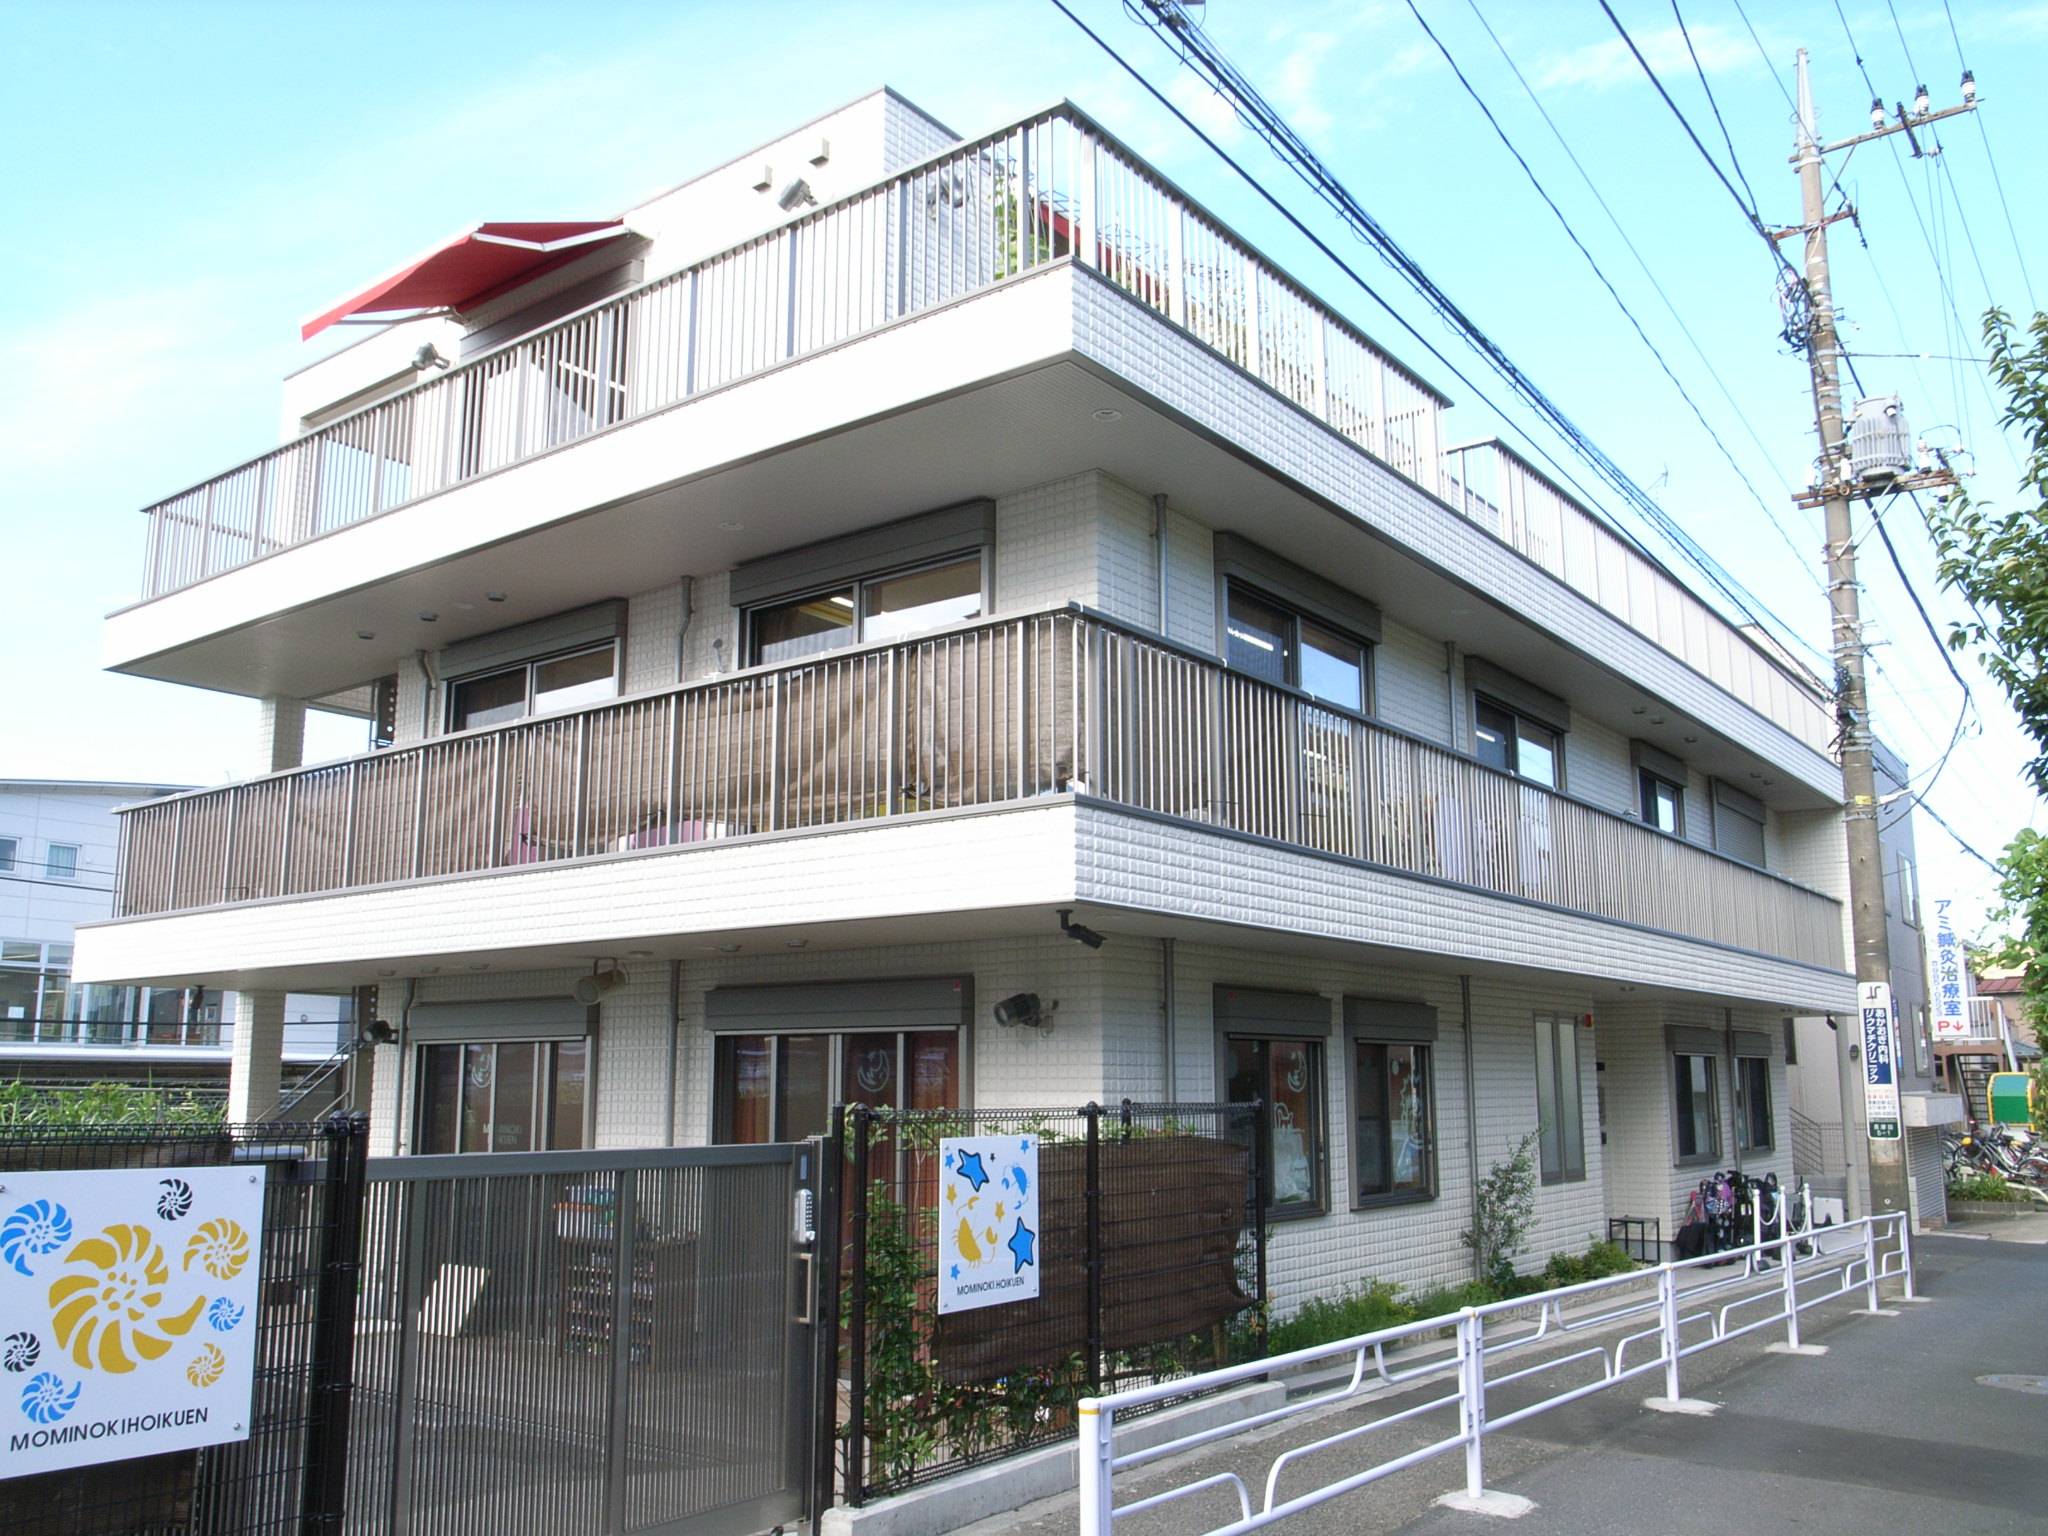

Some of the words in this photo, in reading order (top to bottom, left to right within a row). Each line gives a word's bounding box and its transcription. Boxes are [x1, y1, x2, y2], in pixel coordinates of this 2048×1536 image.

[1934, 899, 1962, 1016] アミ鍼灸治療室
[1866, 1008, 1879, 1084] リウマチクリニック
[1938, 1020, 1950, 1032] P
